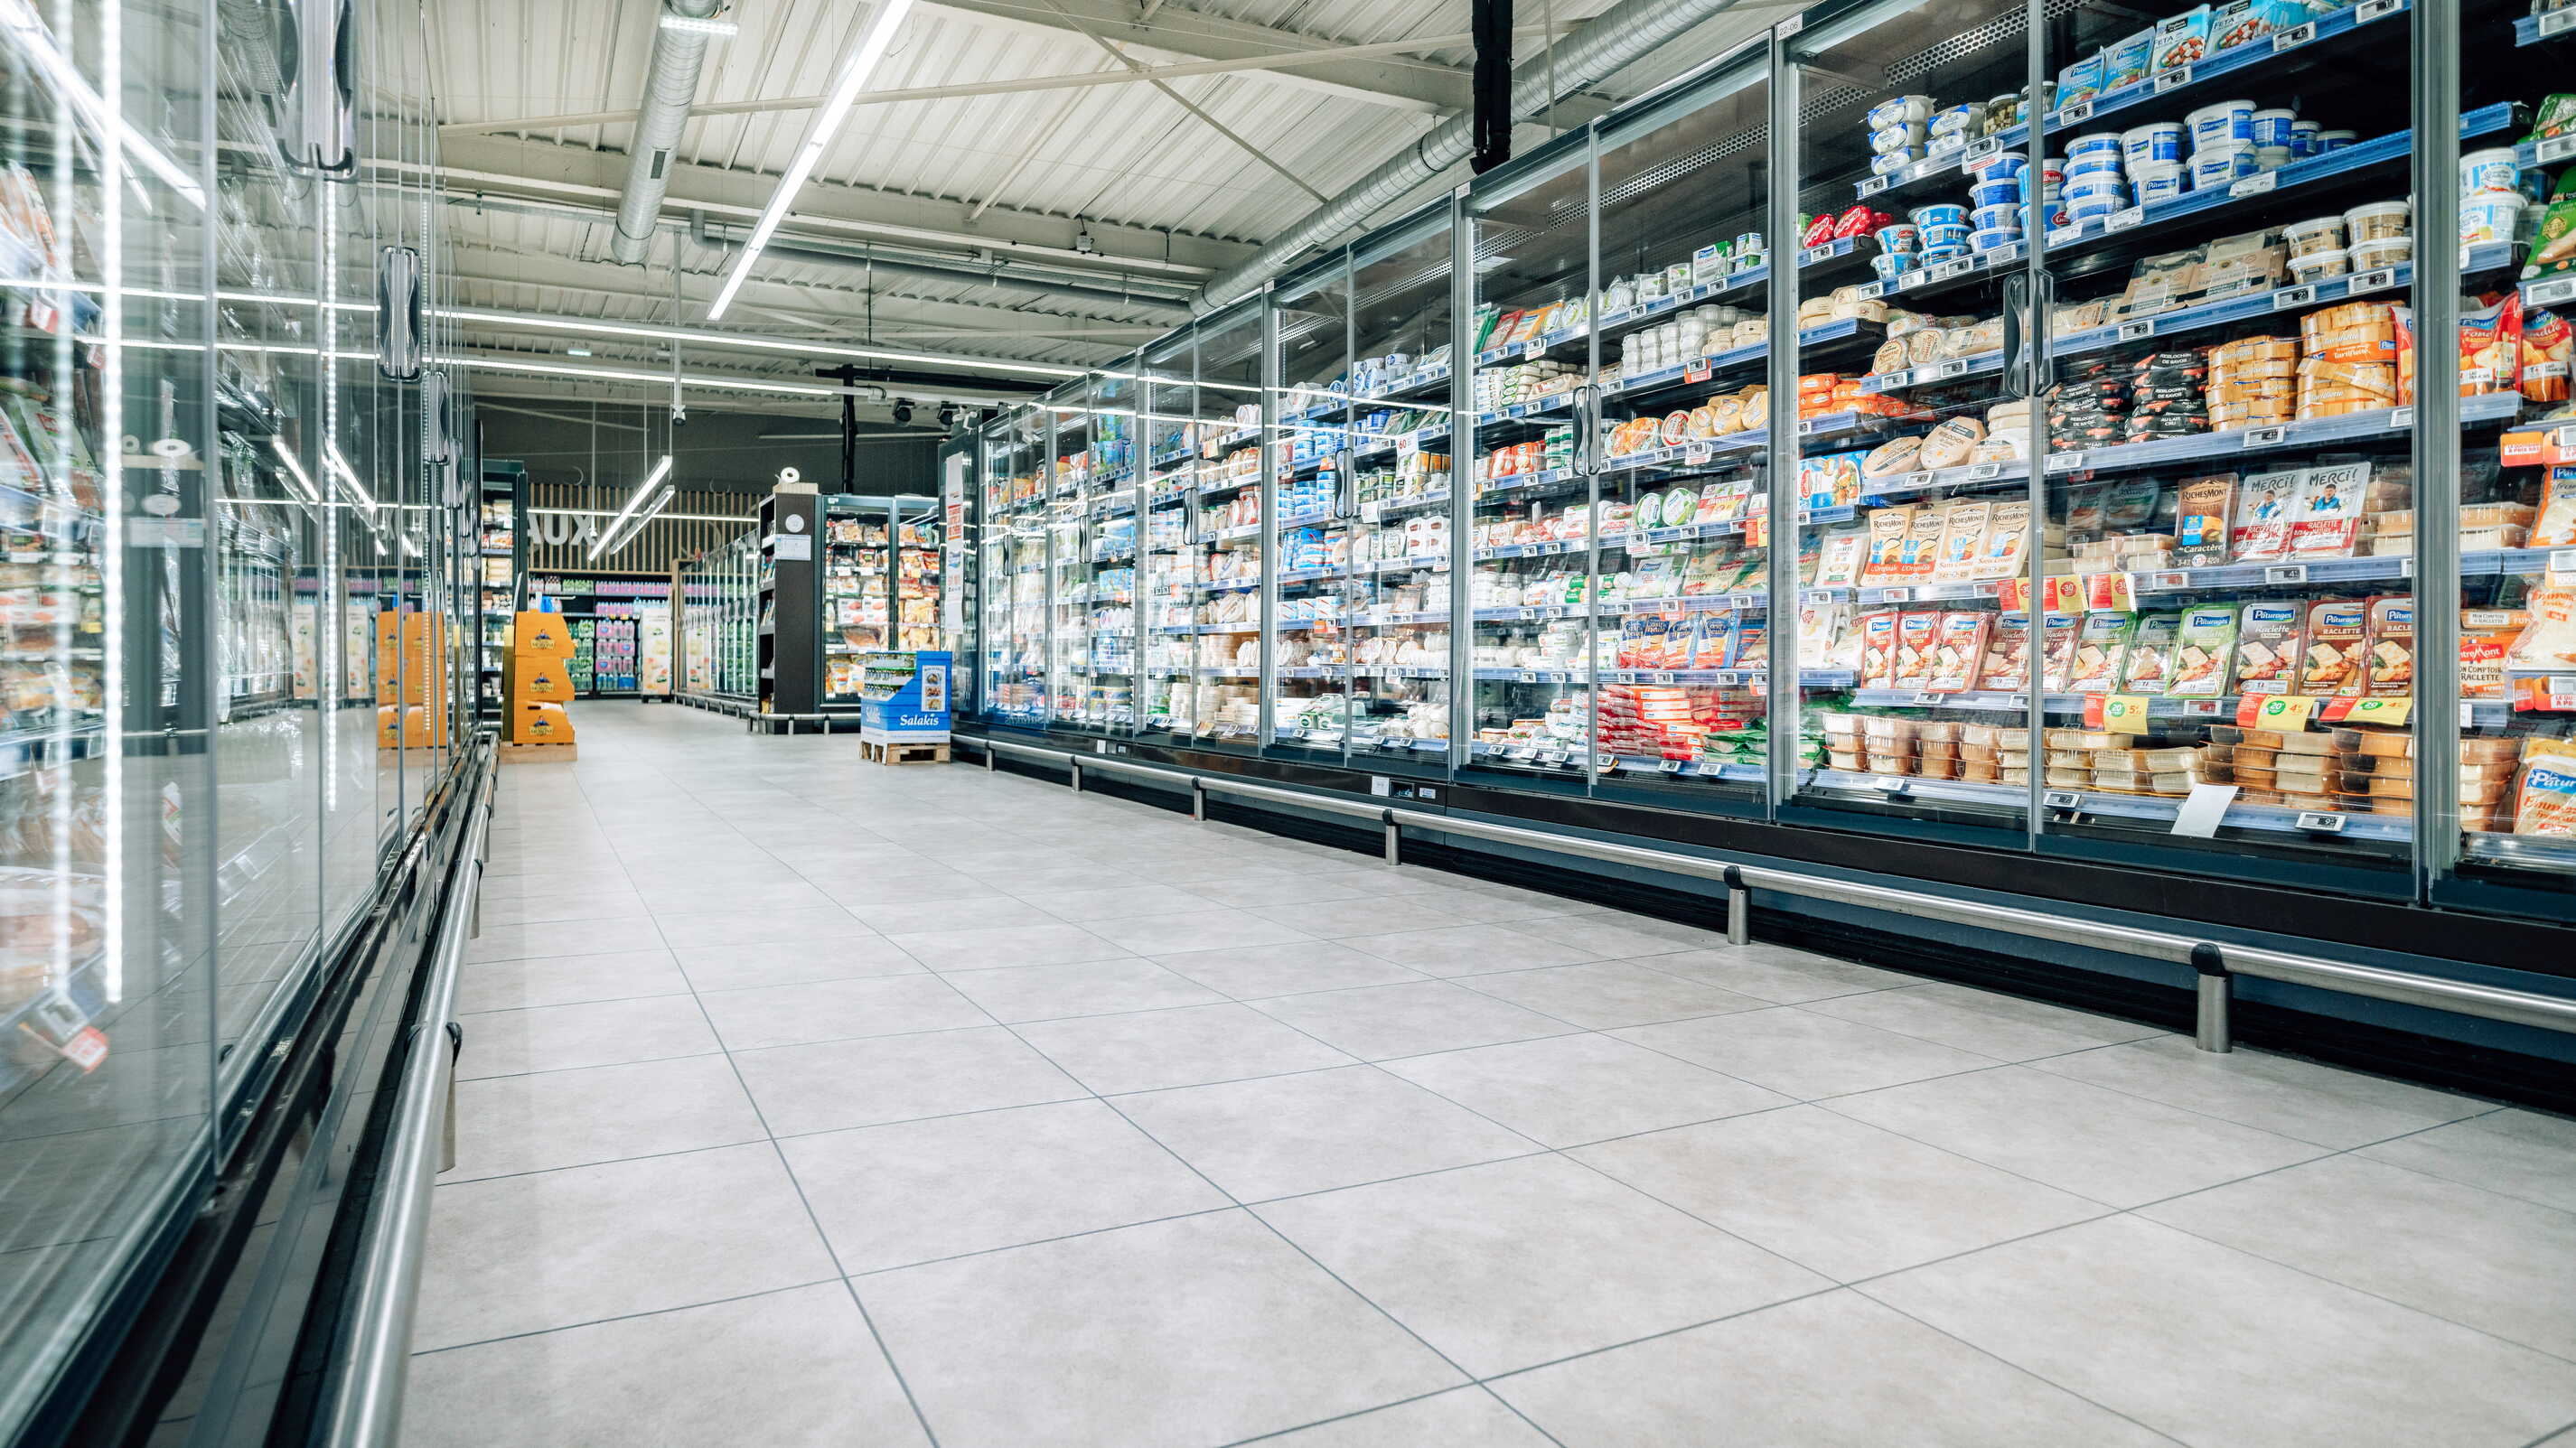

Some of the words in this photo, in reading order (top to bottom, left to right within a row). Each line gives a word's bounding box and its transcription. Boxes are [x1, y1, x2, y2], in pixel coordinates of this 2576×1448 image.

[2254, 610, 2293, 621] Pâturages
[2326, 614, 2363, 625] Pâturages
[2459, 646, 2500, 659] ntreMont
[900, 714, 940, 726] Salakis
